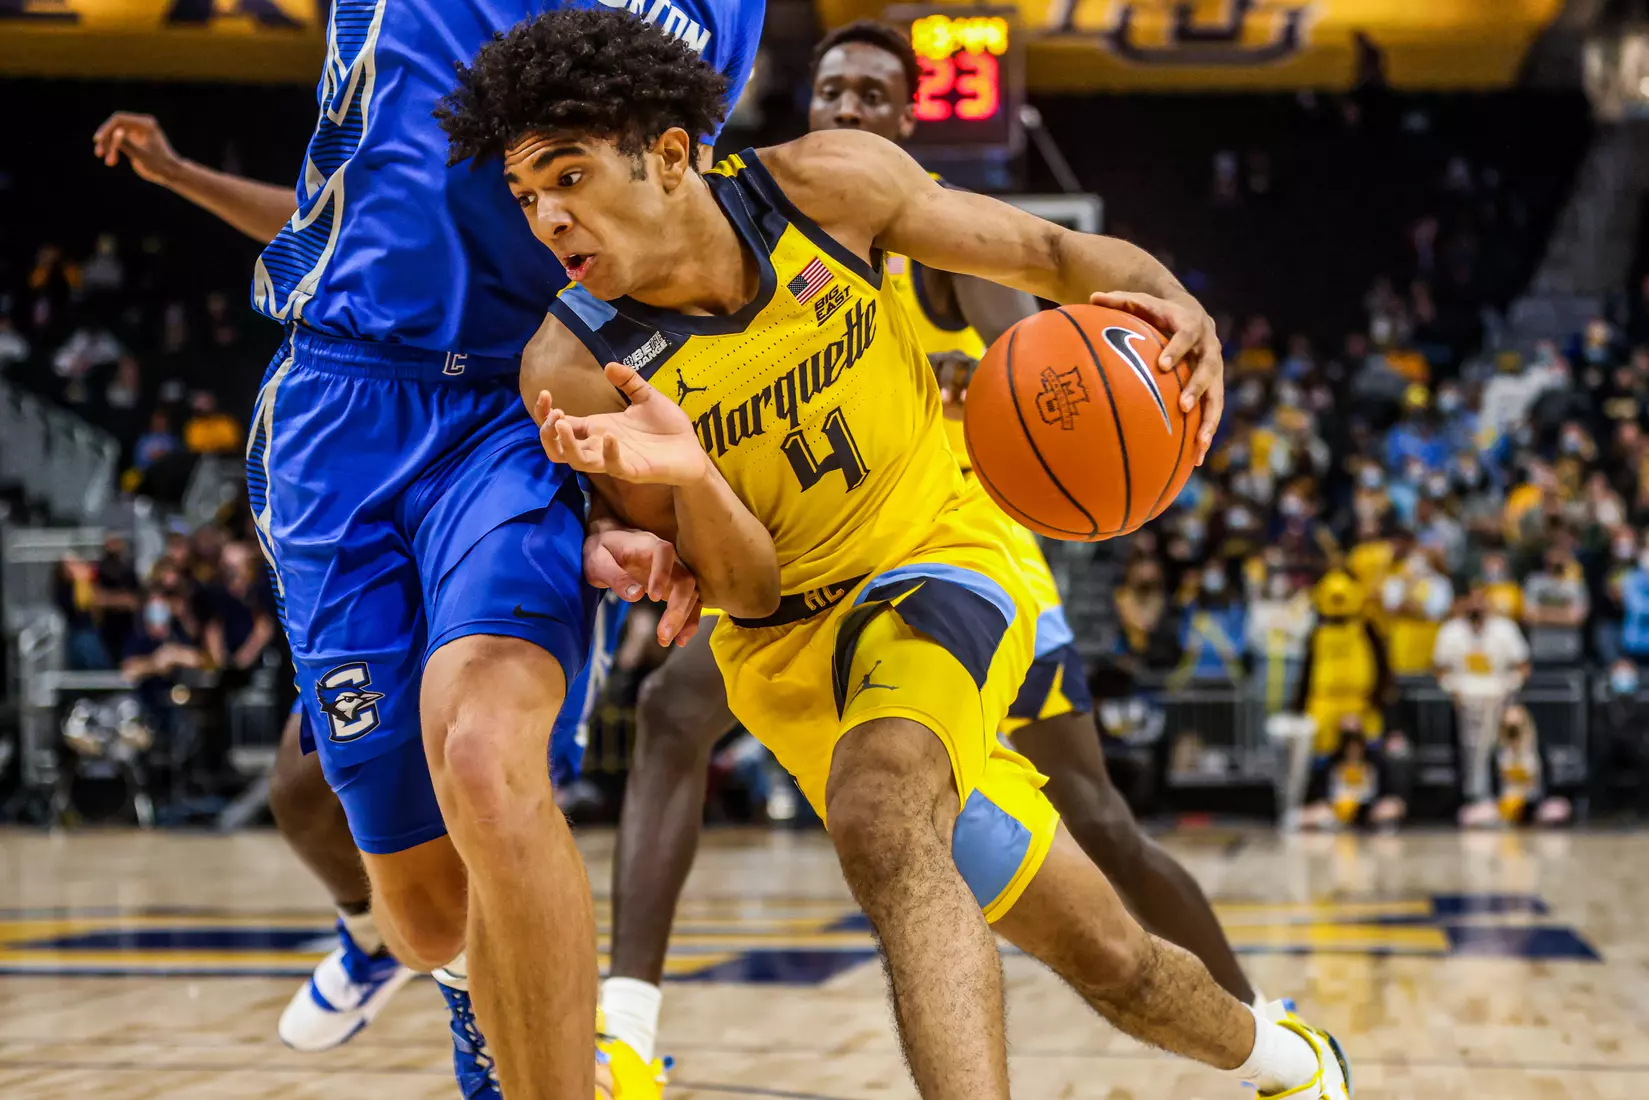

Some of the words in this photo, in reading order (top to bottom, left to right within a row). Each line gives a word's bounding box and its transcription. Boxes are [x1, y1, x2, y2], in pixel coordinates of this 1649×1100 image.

[913, 50, 999, 121] 23
[814, 284, 839, 312] BIG
[816, 285, 851, 322] EAST
[632, 339, 668, 371] HANGE
[692, 298, 877, 458] Marquette
[780, 406, 870, 494] 4
